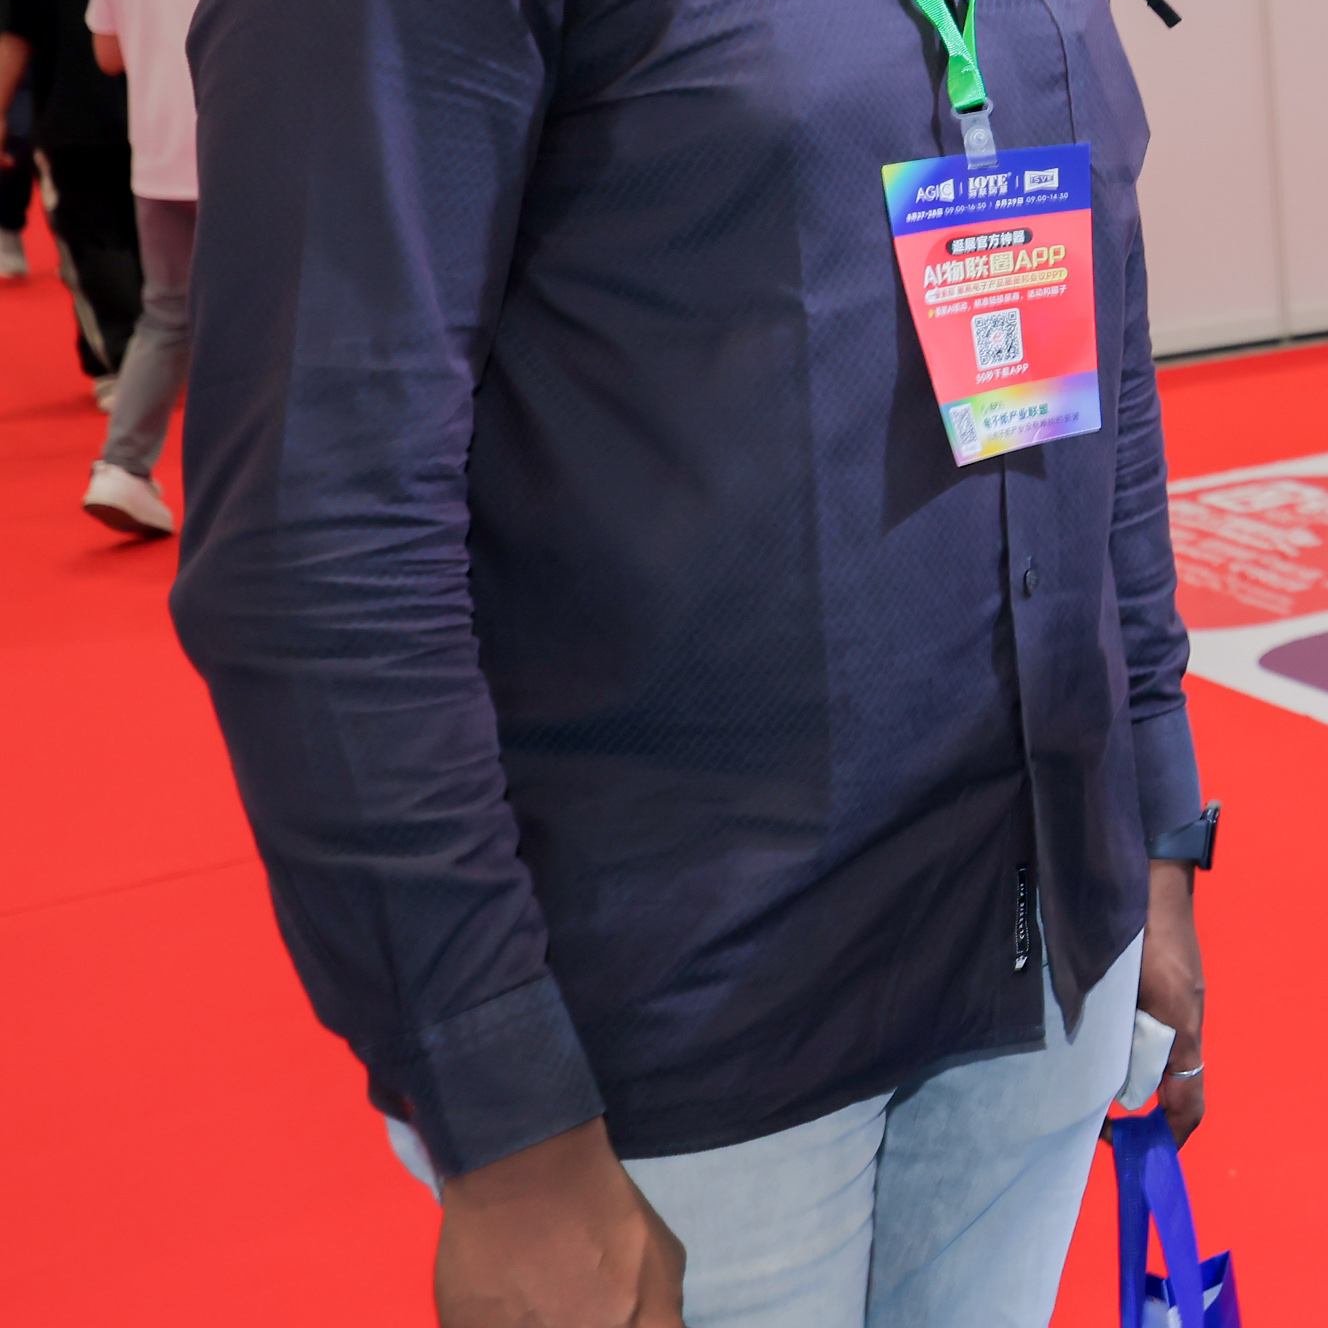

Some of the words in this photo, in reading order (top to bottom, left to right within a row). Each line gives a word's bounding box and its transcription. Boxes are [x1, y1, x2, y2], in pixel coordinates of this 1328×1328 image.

[968, 173, 1009, 189] IOTE
[924, 244, 1066, 288] AI物联圈APP
